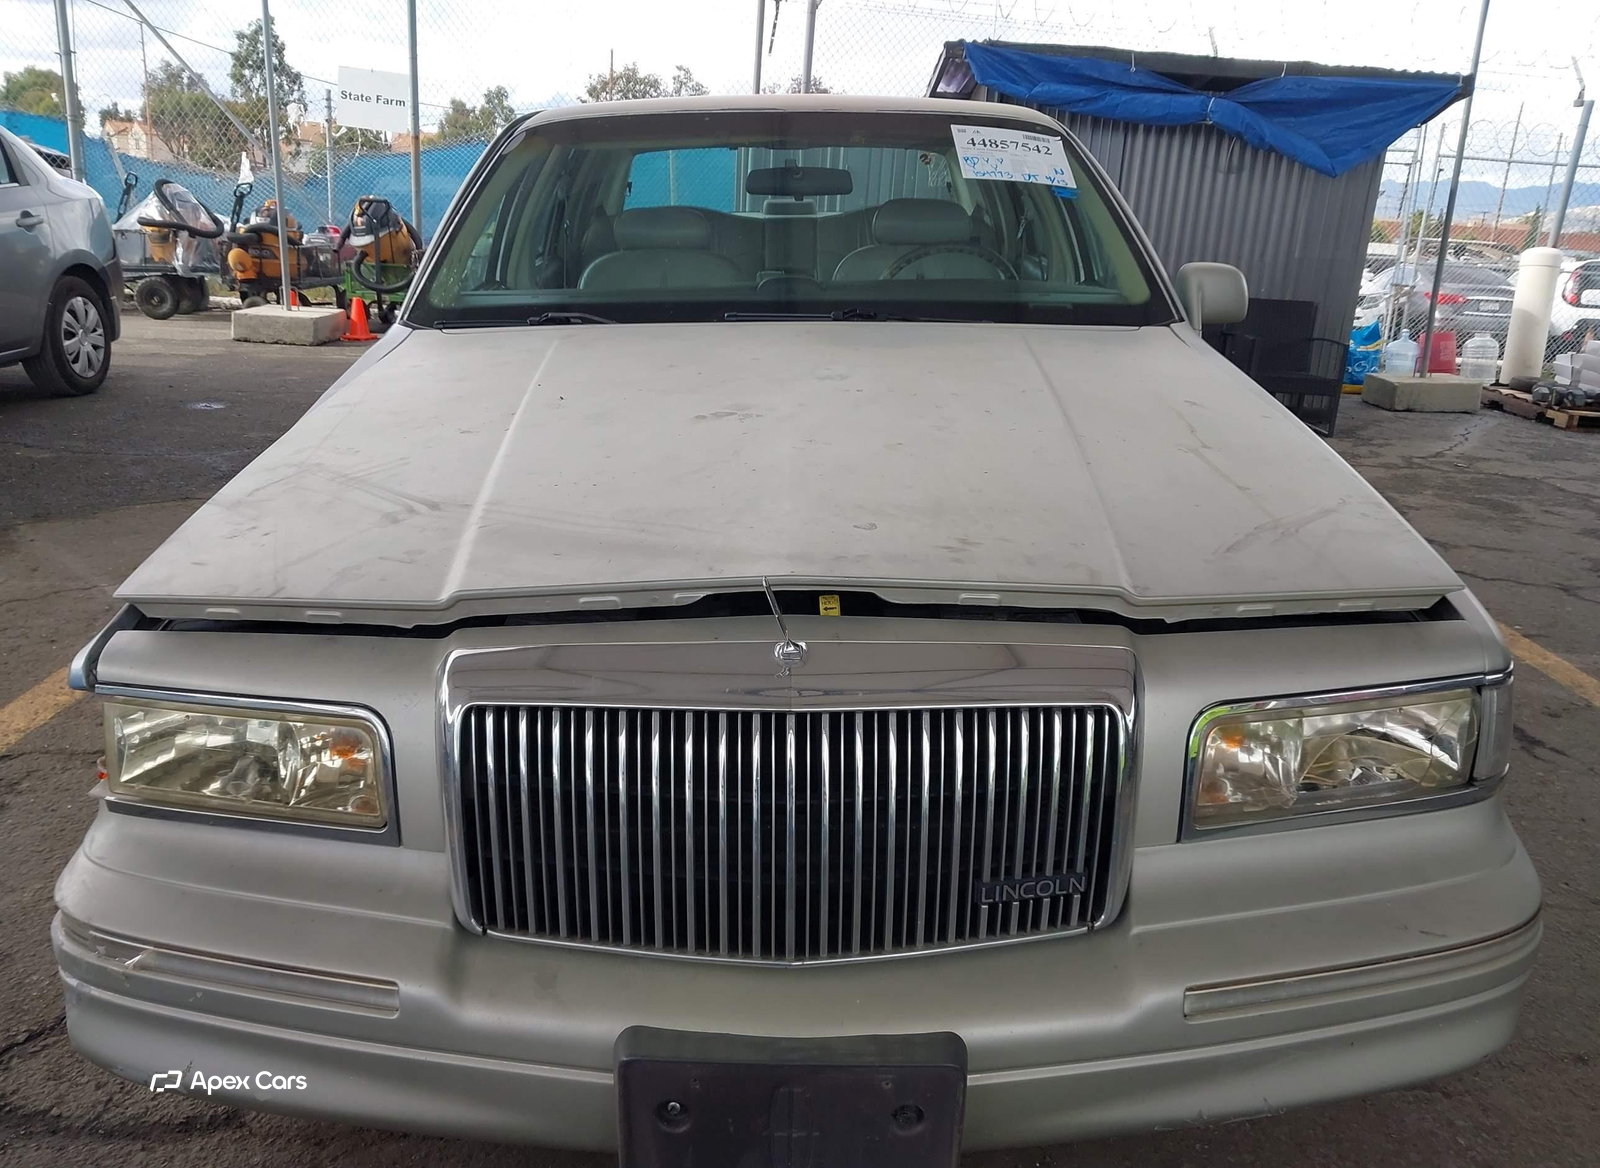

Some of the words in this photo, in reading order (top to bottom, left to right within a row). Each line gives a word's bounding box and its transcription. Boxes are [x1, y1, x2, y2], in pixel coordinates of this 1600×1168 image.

[340, 90, 372, 103] State
[376, 94, 406, 107] Farm
[966, 137, 1053, 156] 44857542
[981, 876, 1086, 903] LINCOLN
